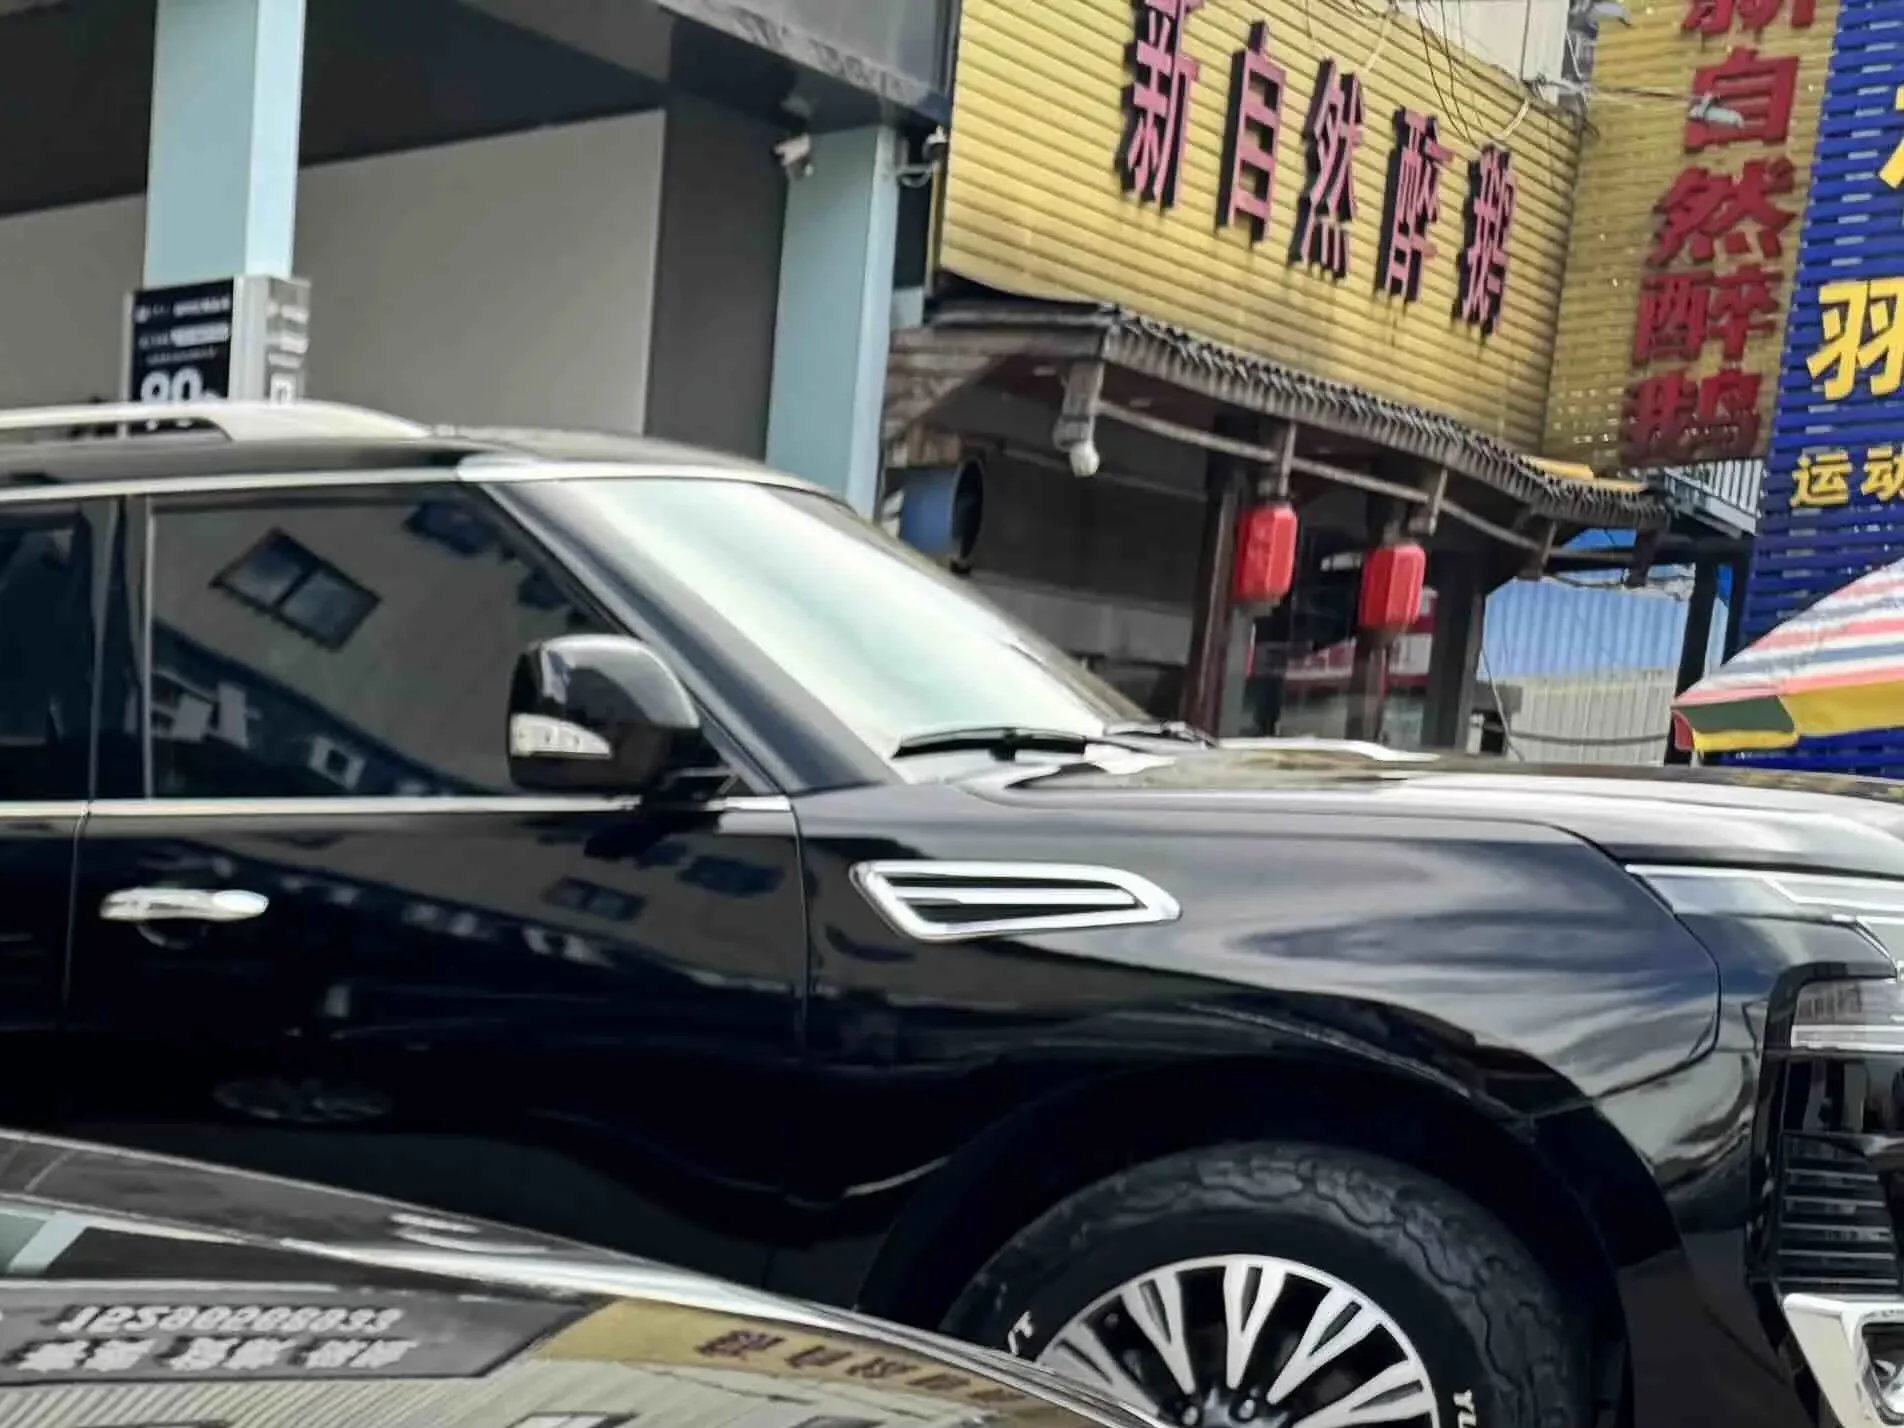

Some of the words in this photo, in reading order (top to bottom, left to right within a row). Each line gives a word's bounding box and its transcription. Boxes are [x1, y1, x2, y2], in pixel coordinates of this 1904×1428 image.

[1118, 0, 1518, 334] 新自然醉鹅
[1621, 0, 1816, 462] 自然醉鹅
[1806, 278, 1904, 400] 羽
[1789, 446, 1904, 506] 运动
